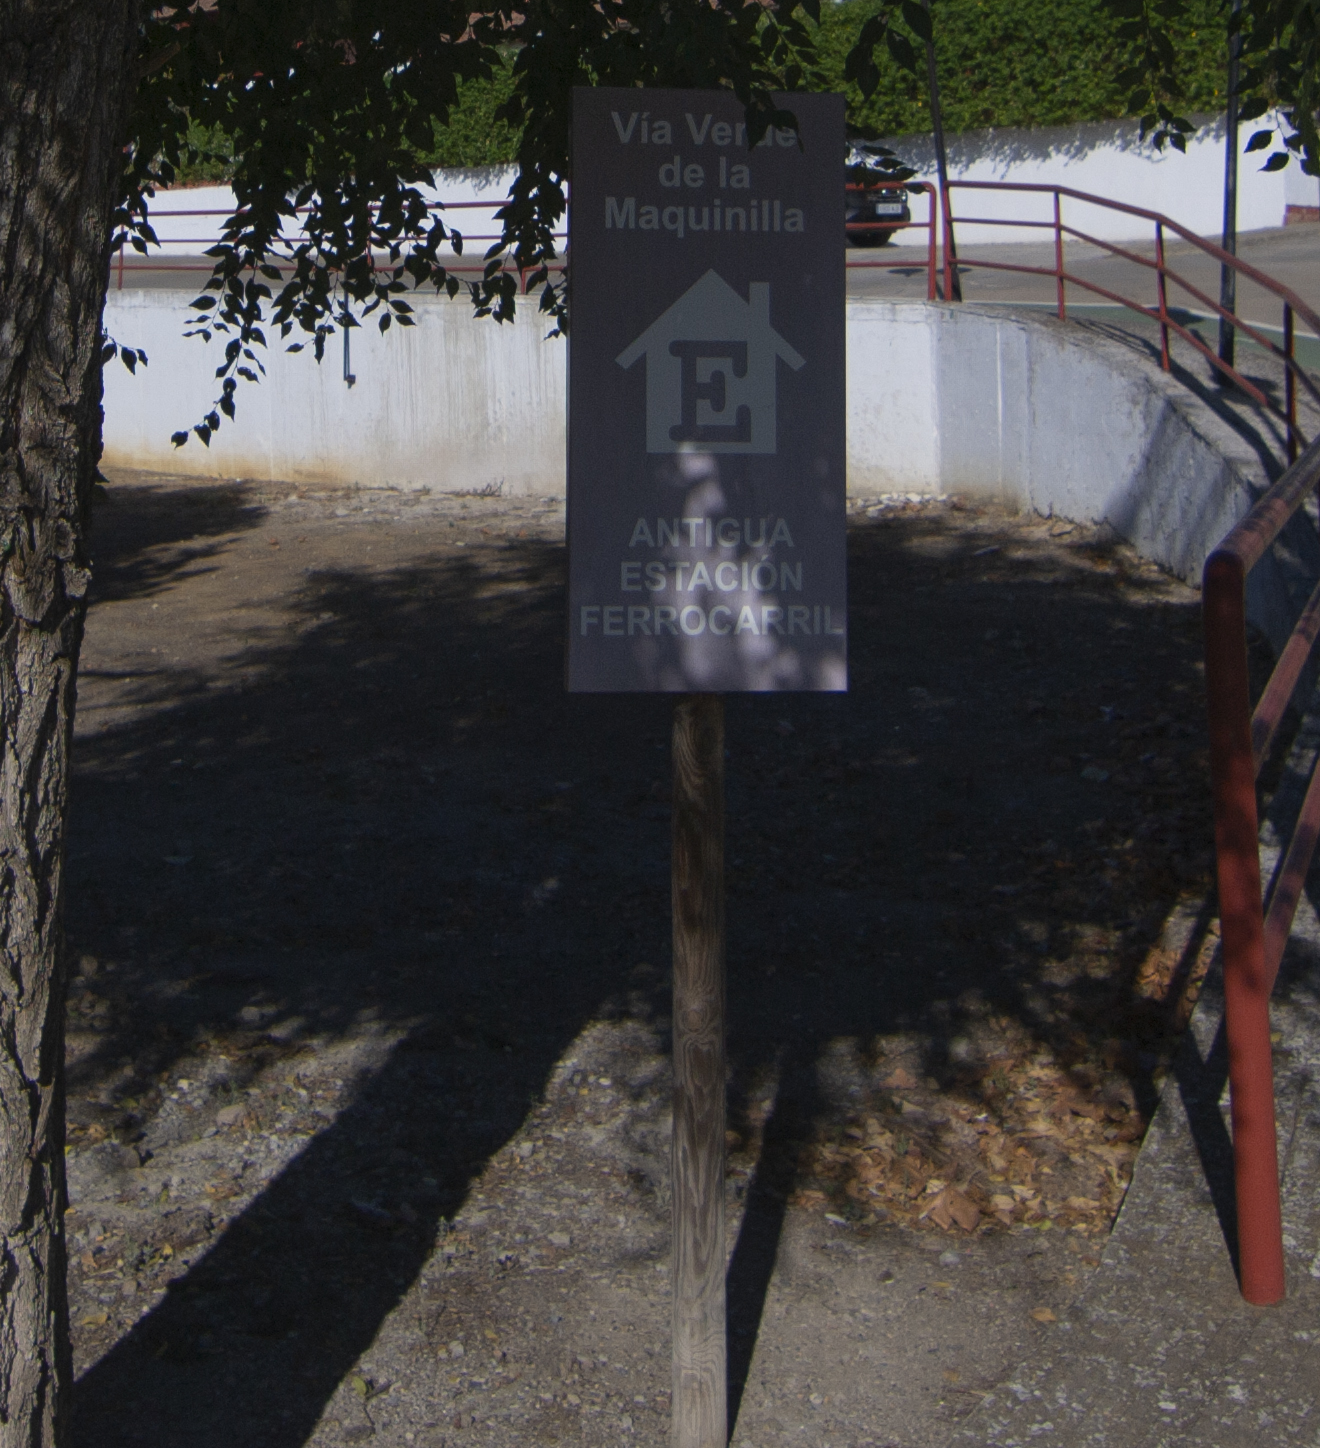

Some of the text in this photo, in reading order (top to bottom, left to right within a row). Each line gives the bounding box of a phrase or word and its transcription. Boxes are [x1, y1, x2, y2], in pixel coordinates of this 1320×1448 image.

[611, 111, 672, 145] Vía
[658, 155, 751, 189] de la
[604, 195, 805, 239] Maquinilla
[629, 517, 795, 548] ANTIGUA
[620, 554, 803, 592] ESTACIÓN
[580, 604, 844, 636] FERROCARRIL
